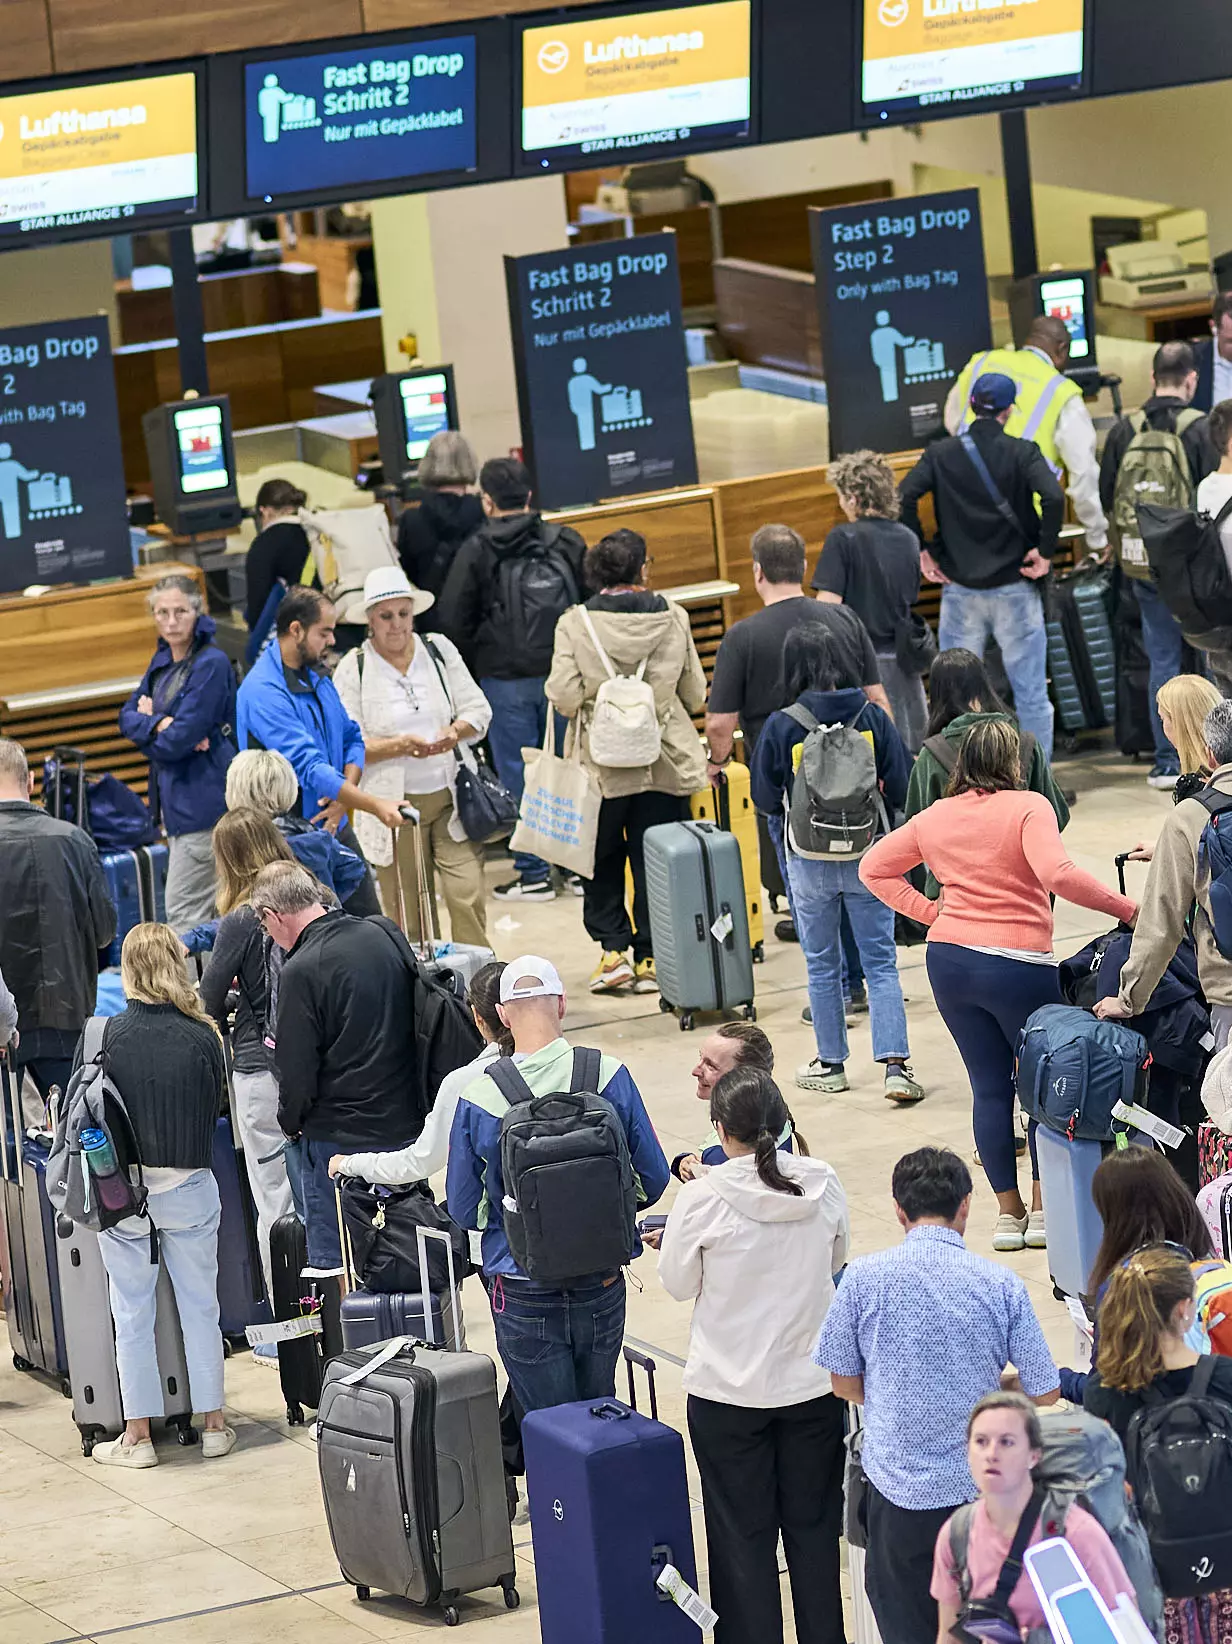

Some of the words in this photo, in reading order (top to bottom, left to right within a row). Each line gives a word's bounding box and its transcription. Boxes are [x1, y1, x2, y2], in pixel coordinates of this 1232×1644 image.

[583, 30, 704, 64] Lufthansa
[323, 62, 367, 88] Fast
[369, 60, 410, 84] Bag
[412, 53, 464, 77] Drop
[323, 86, 392, 115] Schritt
[395, 83, 409, 106] 2
[919, 91, 951, 106] STAR
[952, 82, 1011, 100] ALLIANCE
[19, 105, 147, 140] Lufthansa
[324, 125, 352, 143] Nur
[353, 120, 379, 138] mit
[379, 107, 463, 136] Gepäcklabel
[581, 139, 615, 153] STAR
[616, 129, 677, 148] ALLIANCE
[20, 215, 54, 231] STAR
[56, 206, 121, 226] ALLIANCE
[831, 218, 872, 243] Fast
[877, 215, 917, 238] Bag
[921, 208, 970, 231] Drop
[528, 265, 569, 291] Fast
[573, 260, 613, 283] Bag
[617, 252, 668, 276] Drop
[834, 250, 877, 272] Step
[882, 244, 894, 264] 2
[837, 281, 868, 300] Only
[871, 276, 900, 294] with
[904, 274, 930, 290] Bag
[933, 270, 958, 286] Tag
[531, 290, 595, 319] Schritt
[600, 287, 611, 307] 2
[534, 332, 558, 347] Nur
[563, 325, 585, 342] mit
[588, 310, 671, 338] Gepäcklabel
[0, 344, 39, 368] Bag
[44, 336, 99, 360] Drop
[3, 373, 16, 395] 2
[28, 404, 56, 422] Bag
[59, 400, 86, 418] Tag
